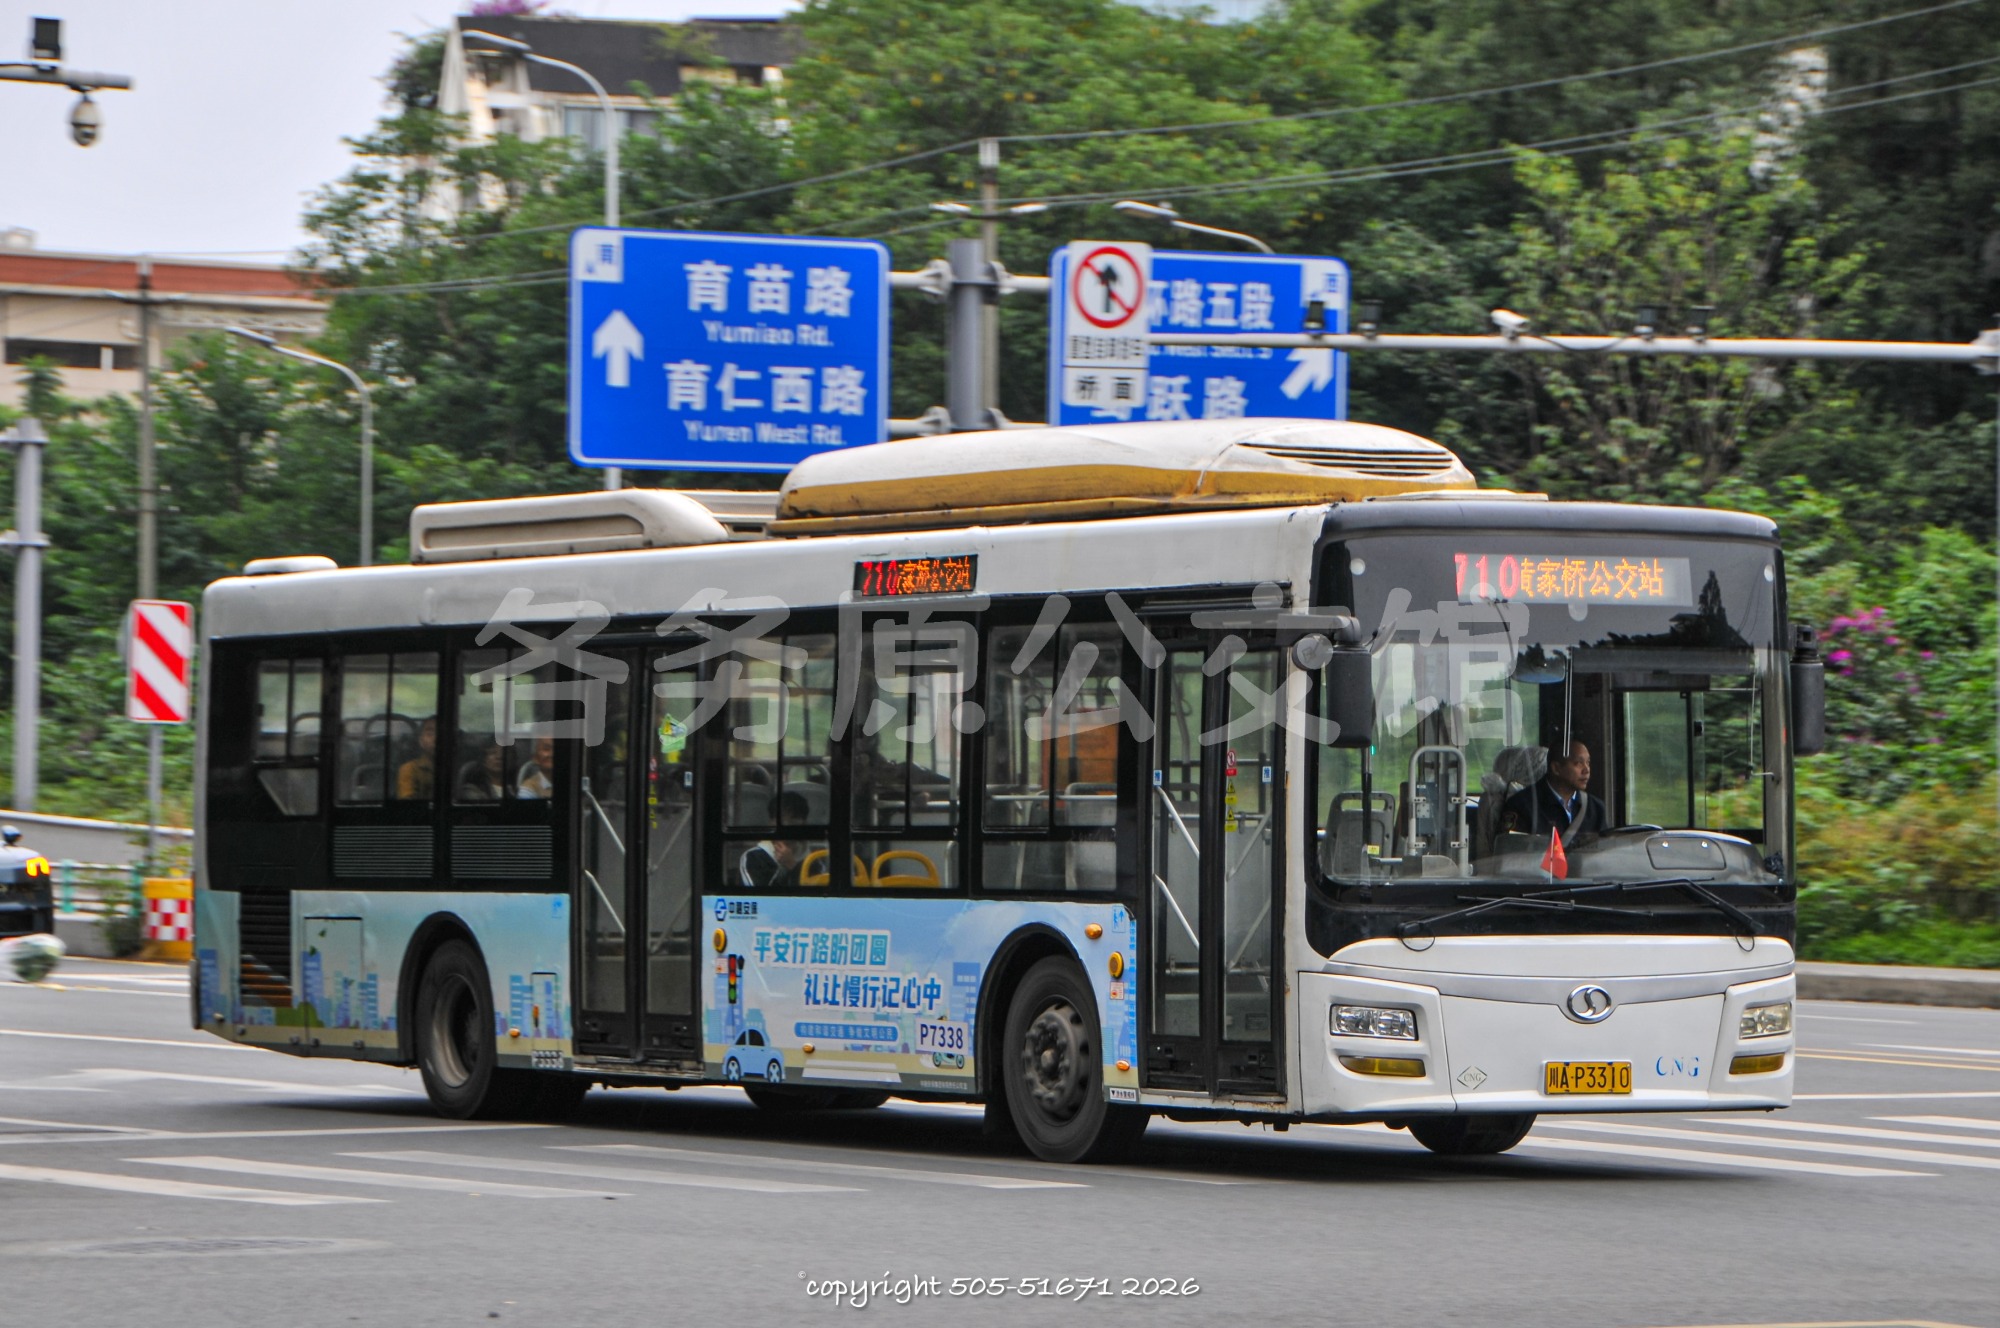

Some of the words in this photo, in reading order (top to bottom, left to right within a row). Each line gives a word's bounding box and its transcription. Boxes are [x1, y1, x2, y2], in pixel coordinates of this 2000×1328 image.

[683, 260, 854, 317] 育苗路
[702, 320, 795, 345] Yumiao
[796, 324, 834, 346] Rd.
[663, 359, 868, 416] 育仁西路
[683, 419, 753, 443] Yuren
[755, 422, 809, 444] West
[811, 424, 847, 446] Rd.
[863, 560, 898, 595] 710
[1454, 553, 1520, 598] 710
[754, 931, 888, 966] 平安行路盼团圆
[804, 973, 942, 1011] 礼让慢行记心中
[920, 1024, 963, 1049] P7338
[1463, 1073, 1482, 1084] CNG
[1656, 1056, 1700, 1078] CNG
